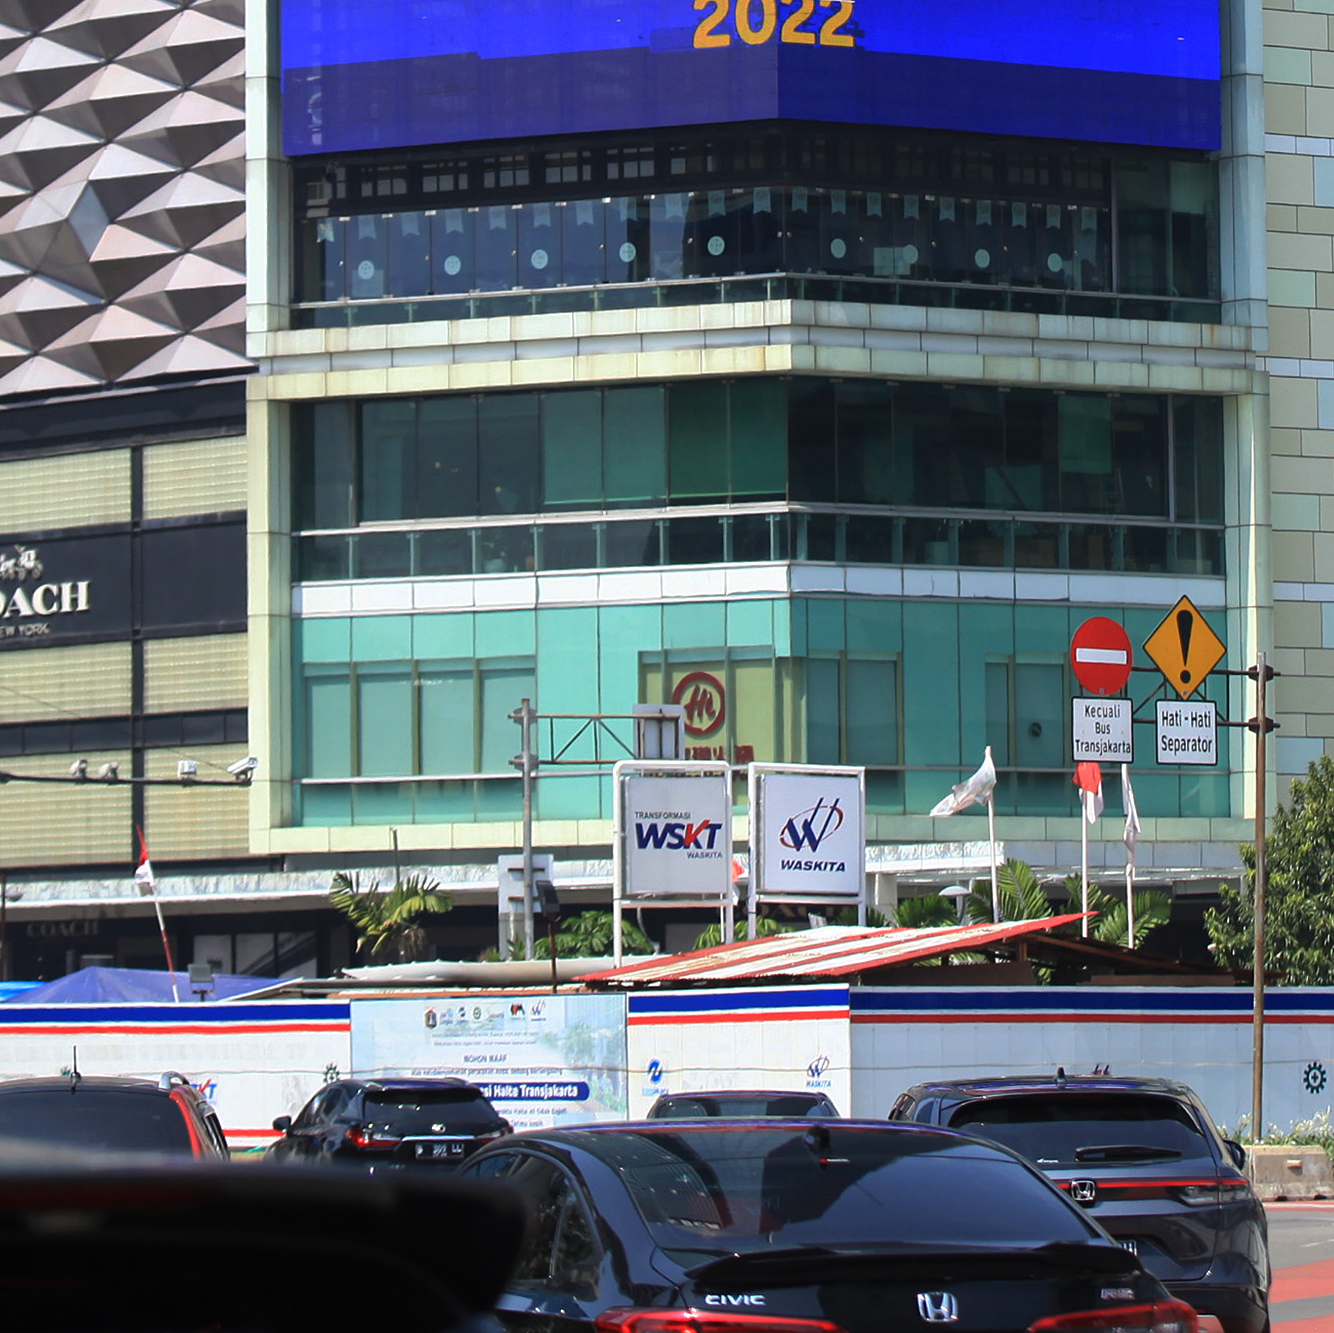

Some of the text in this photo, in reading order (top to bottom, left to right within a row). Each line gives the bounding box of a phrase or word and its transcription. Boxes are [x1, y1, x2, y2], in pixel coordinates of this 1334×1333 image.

[18, 622, 50, 636] YORK
[1084, 704, 1121, 718] Kecuali
[1161, 710, 1182, 727] Hati
[1190, 711, 1211, 728] Hati
[1095, 722, 1111, 735] Bus
[1075, 739, 1131, 756] Transjakarta
[1161, 735, 1213, 756] Separator
[635, 811, 691, 820] TRANSFORMASI
[635, 819, 723, 850] WSKT
[687, 851, 723, 859] WASKITA
[780, 859, 846, 873] WASKITA
[520, 1084, 579, 1100] Transjakarta
[705, 1294, 766, 1306] CIVIC
